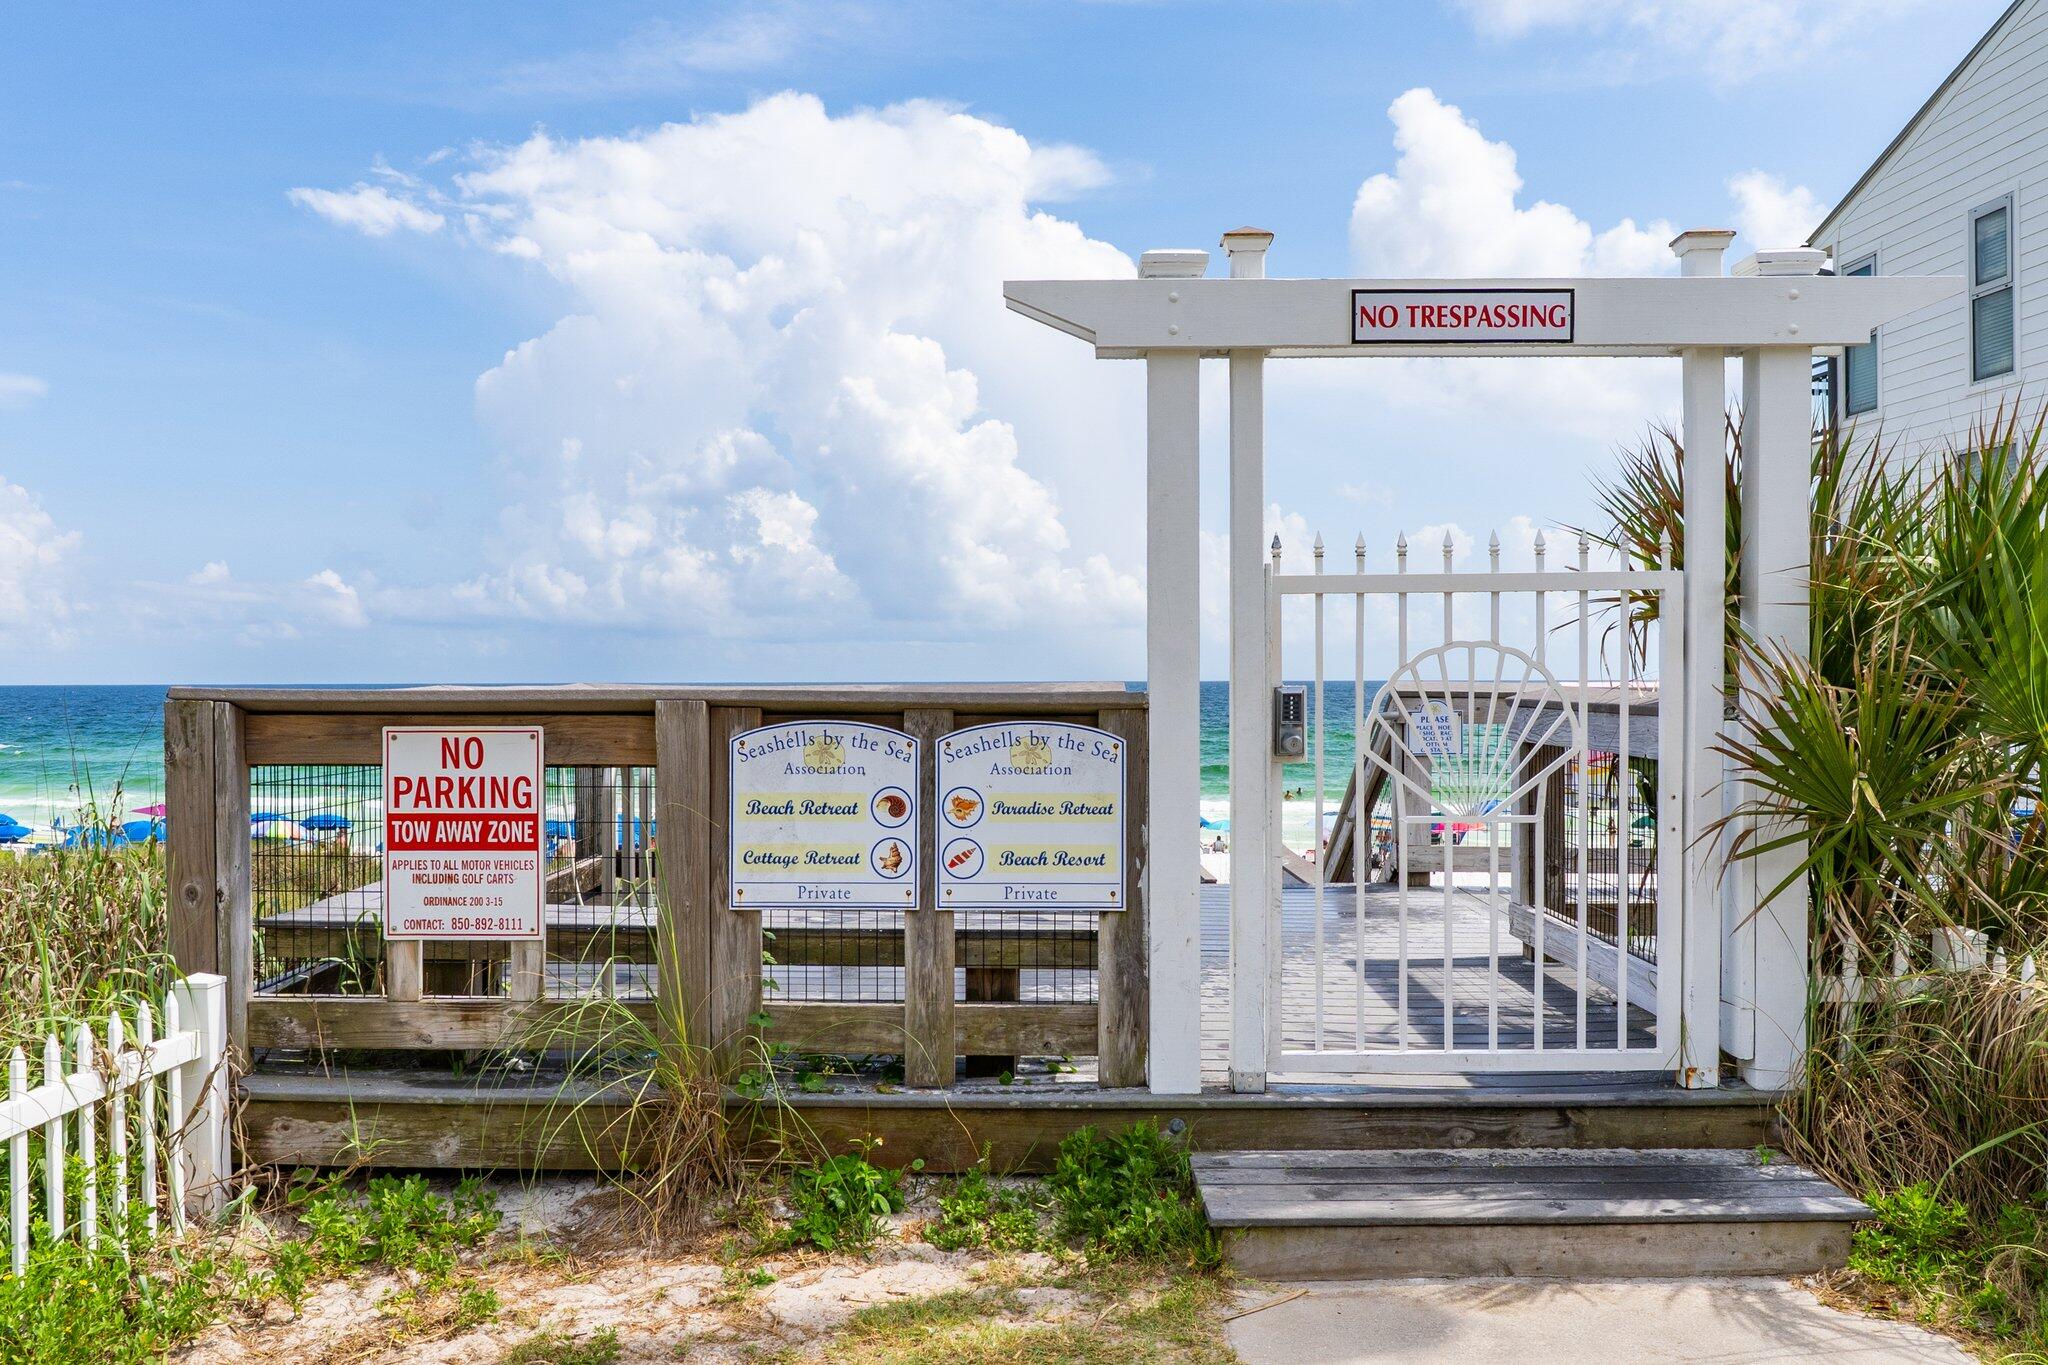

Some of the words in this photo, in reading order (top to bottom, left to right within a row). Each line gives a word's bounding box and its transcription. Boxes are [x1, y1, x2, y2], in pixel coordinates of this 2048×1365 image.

[1360, 305, 1399, 328] NO
[1406, 304, 1566, 328] TRESPASSING
[441, 736, 484, 770] NO
[737, 731, 816, 763] Seashells
[823, 729, 844, 749] by
[851, 733, 879, 751] the
[884, 740, 912, 763] Sea
[943, 731, 1021, 763] Seashells
[1030, 730, 1050, 750] by
[1058, 733, 1085, 752] the
[1091, 740, 1118, 764] Sea
[784, 762, 866, 775] Association
[990, 762, 1072, 775] Association
[393, 776, 532, 809] PARKING
[745, 799, 795, 815] Beach
[799, 799, 858, 815] Retreat
[991, 800, 1054, 815] Paradise
[1059, 800, 1114, 815] Retreat
[391, 820, 431, 843] TOW
[435, 820, 483, 843] AWAY
[487, 820, 534, 843] ZONE
[392, 859, 427, 870] APPLIES
[430, 859, 441, 870] TO
[443, 859, 458, 870] ALL
[461, 859, 491, 870] MOTOR
[493, 859, 534, 870] VEHICLES
[743, 850, 799, 869] Cottage
[804, 850, 861, 865] Retreat
[999, 850, 1048, 866] Beach
[1052, 850, 1106, 866] Resort
[412, 873, 459, 884] INCLUDING
[462, 873, 484, 884] GOLF
[486, 873, 514, 884] CARTS
[797, 885, 851, 899] Private
[1004, 886, 1058, 900] Private
[423, 896, 467, 907] ORDINANCE
[404, 919, 445, 930] CONTACT:
[451, 917, 523, 930] 850-892-8111
